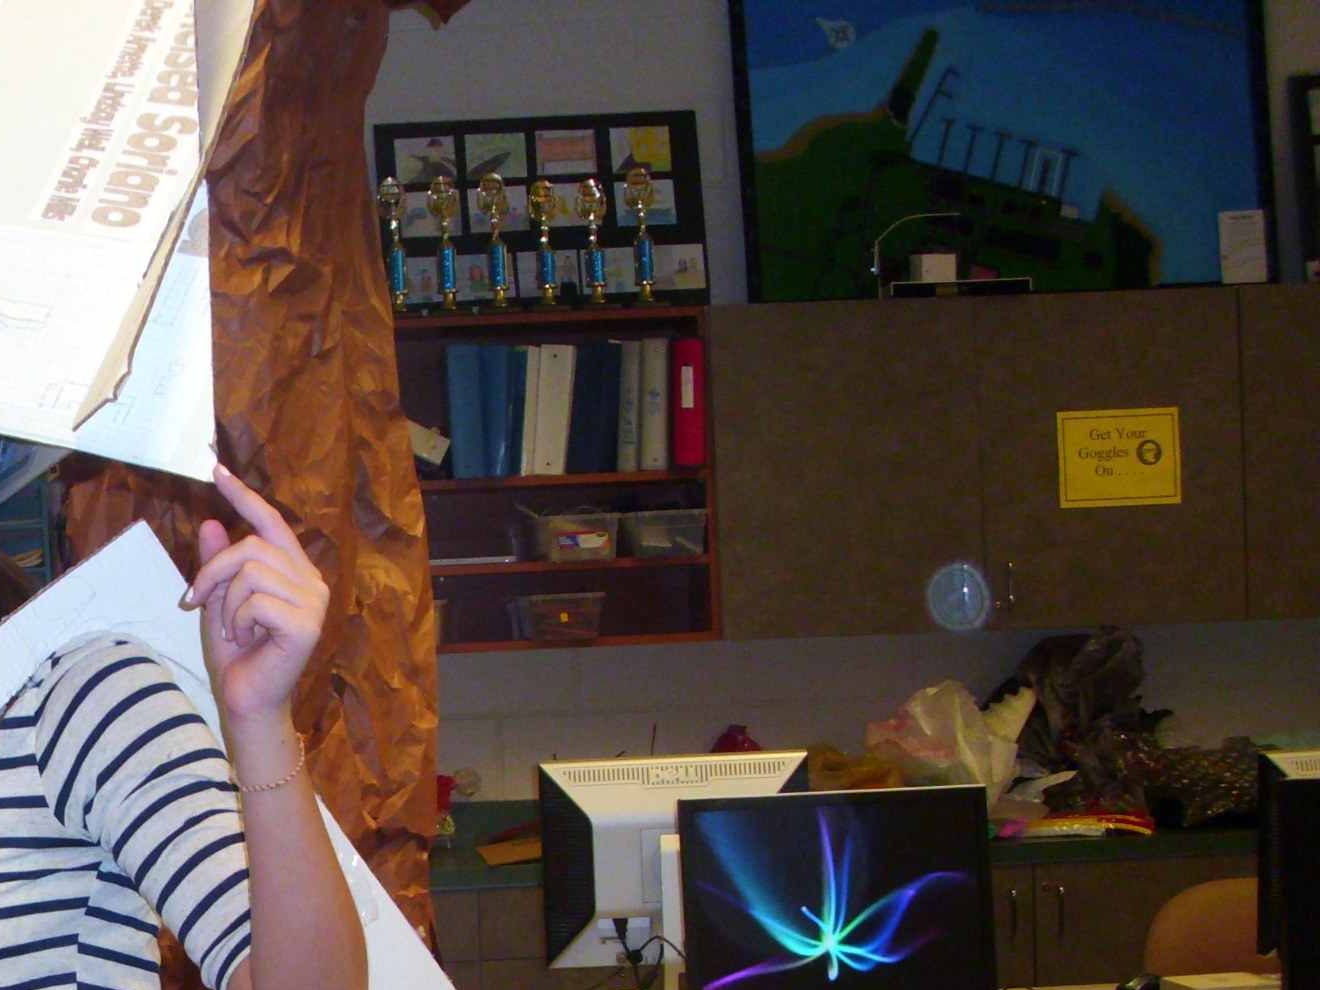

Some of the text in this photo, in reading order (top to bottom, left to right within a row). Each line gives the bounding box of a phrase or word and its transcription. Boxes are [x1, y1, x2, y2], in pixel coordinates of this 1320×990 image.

[80, 82, 135, 126] Lindsay
[91, 112, 199, 228] Soriano
[1089, 427, 1148, 441] Get Your
[1078, 446, 1129, 462] Goggles
[1095, 464, 1114, 477] On
